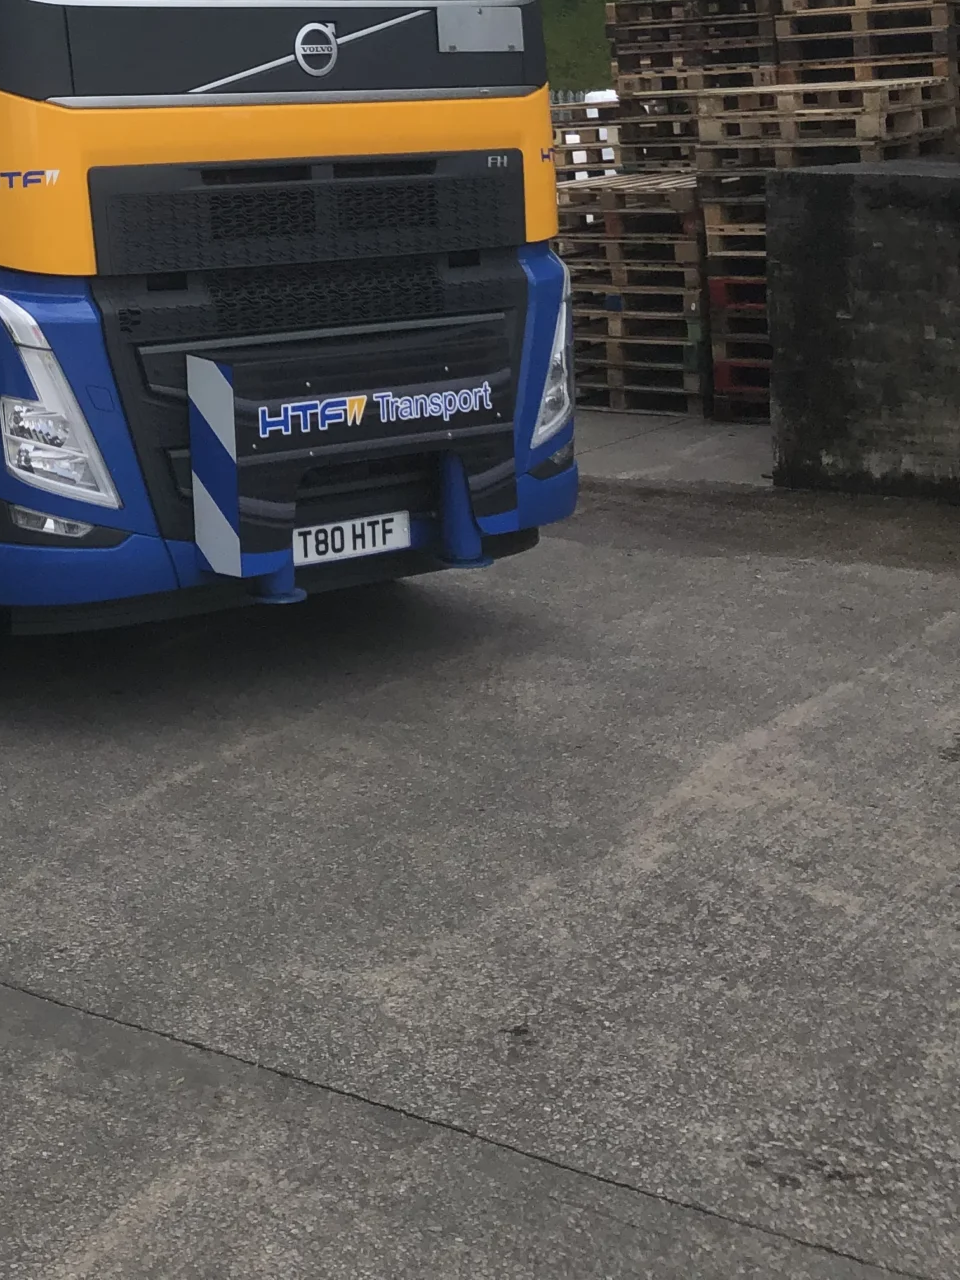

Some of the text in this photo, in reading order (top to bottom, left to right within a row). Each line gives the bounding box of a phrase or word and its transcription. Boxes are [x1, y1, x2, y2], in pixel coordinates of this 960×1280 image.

[487, 155, 508, 168] FH
[259, 381, 493, 438] HTF Transport
[298, 518, 395, 558] T80 HTF
